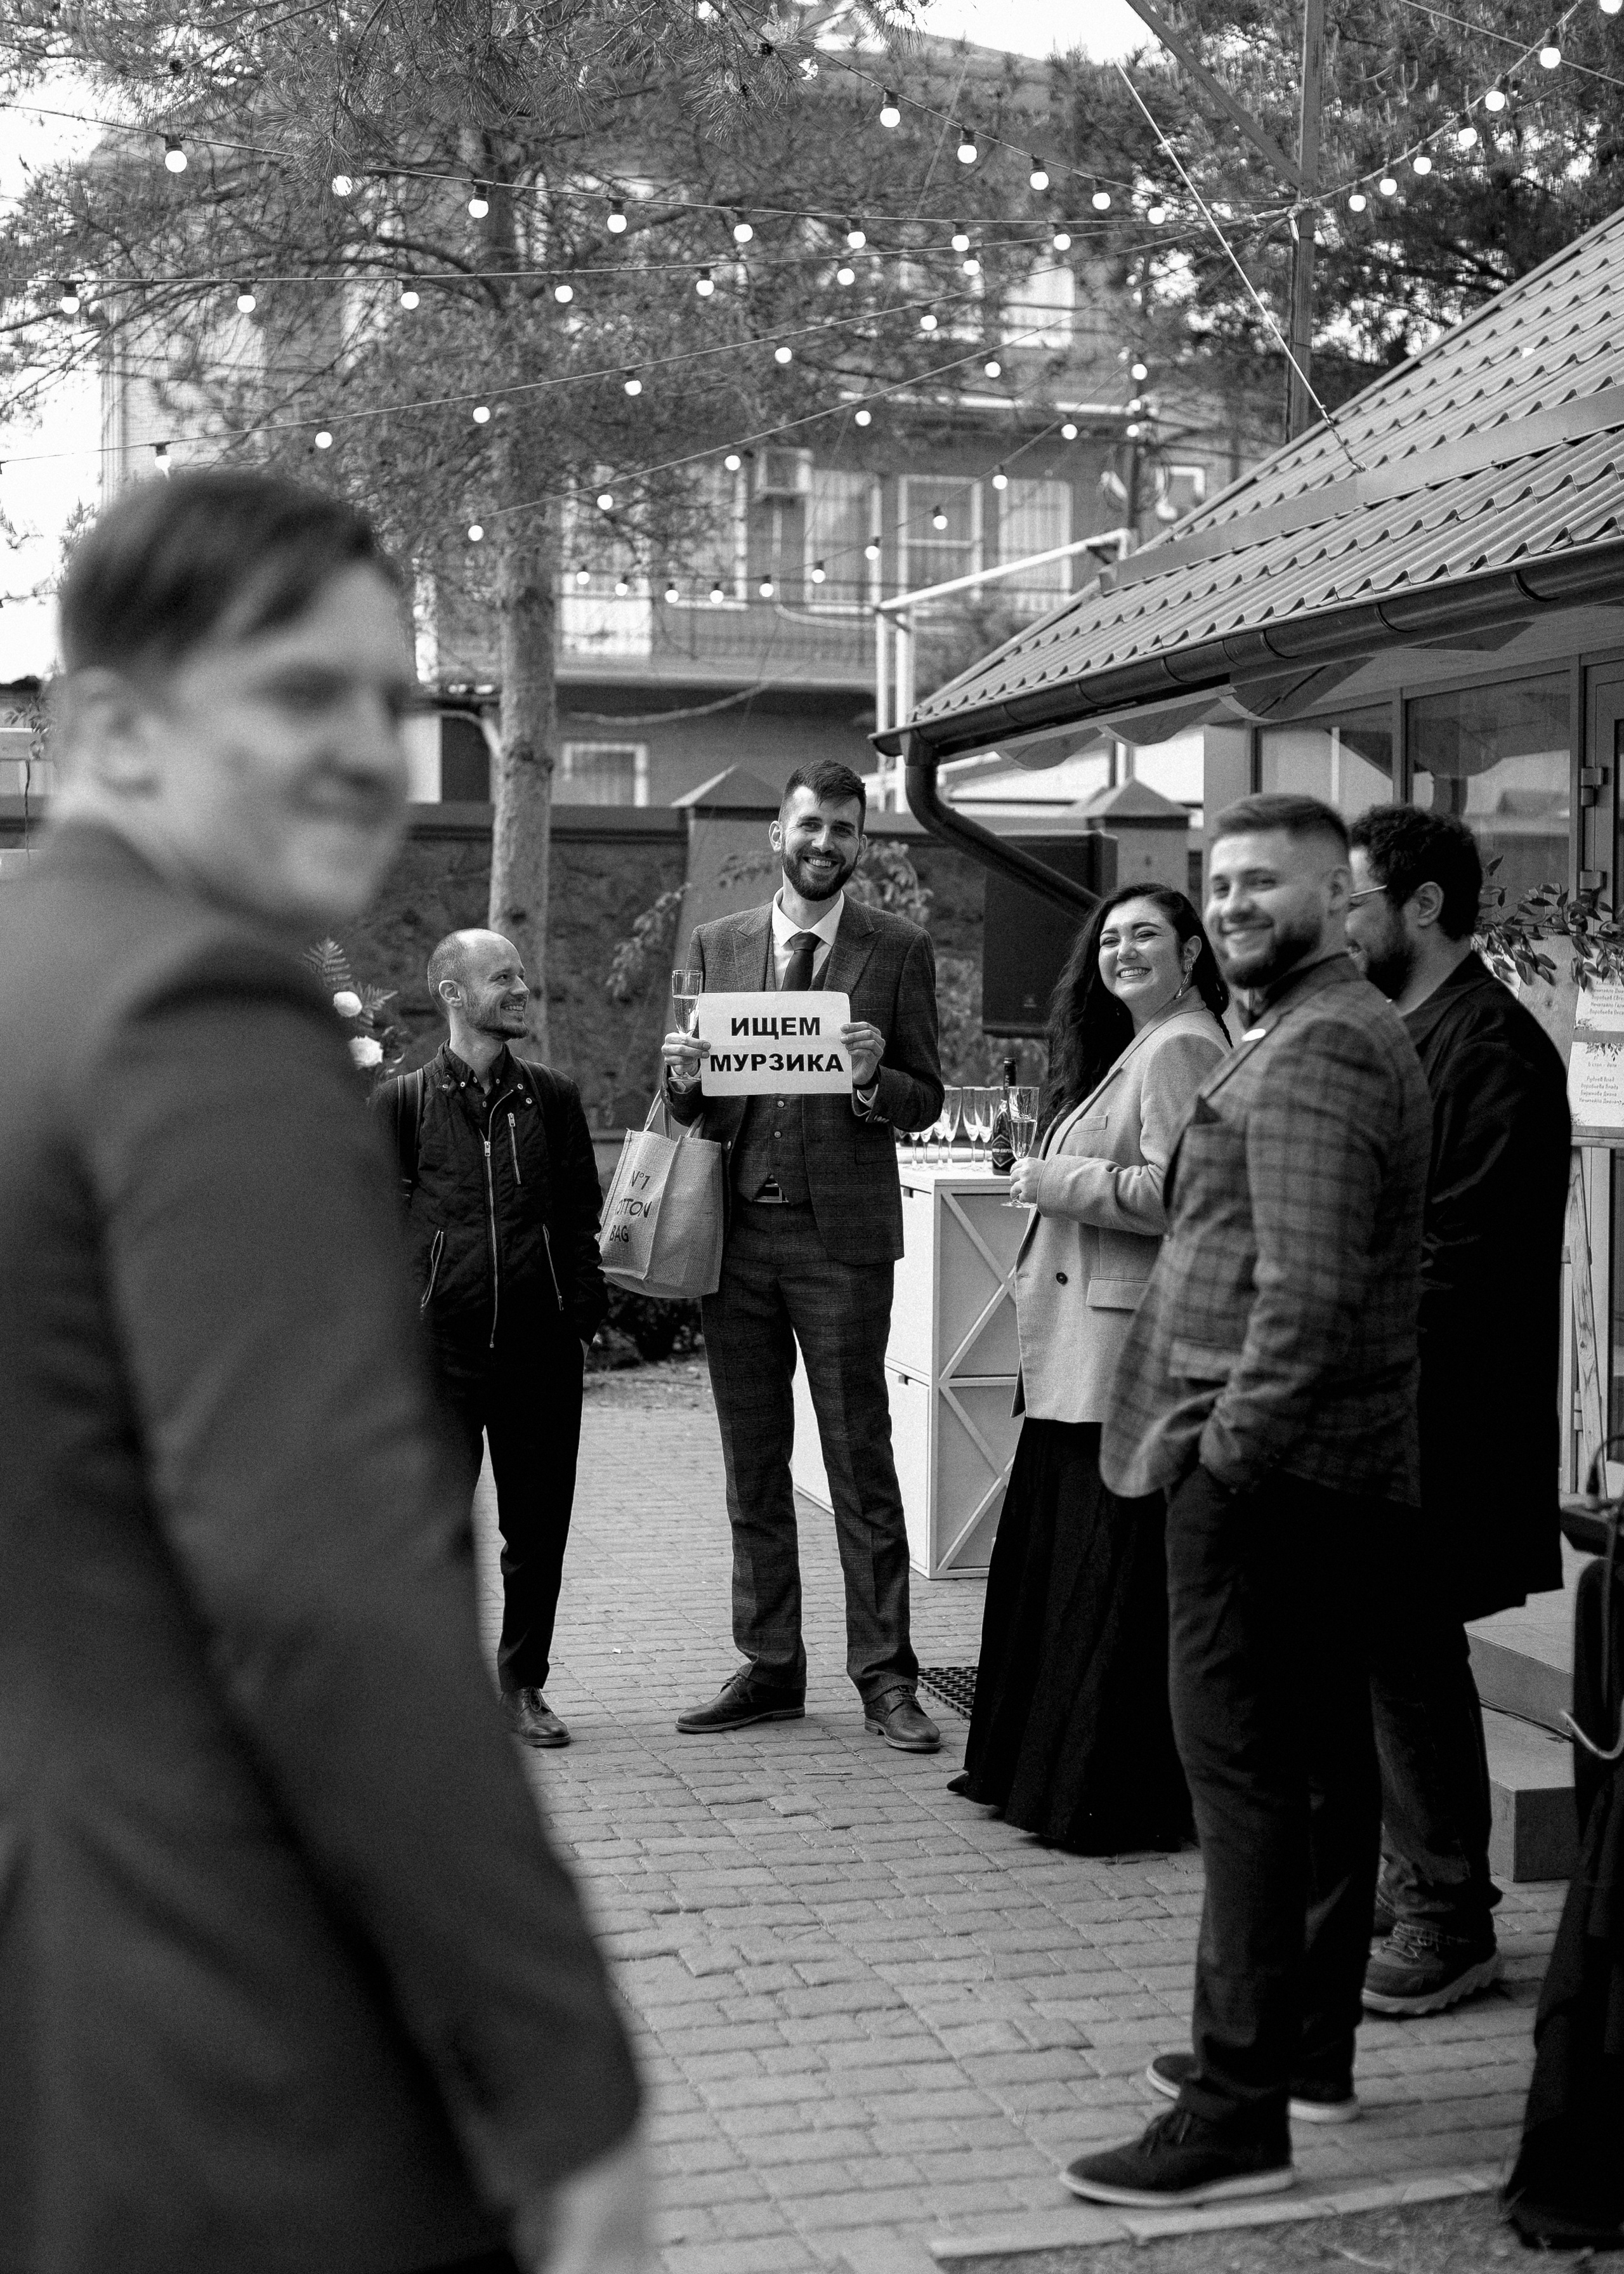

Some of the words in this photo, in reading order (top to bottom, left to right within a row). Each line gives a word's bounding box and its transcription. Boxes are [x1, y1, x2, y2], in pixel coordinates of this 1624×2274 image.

[731, 1017, 820, 1040] ИЩЕМ
[710, 1053, 844, 1072] МУРЗИКА
[609, 1225, 629, 1243] BAG
